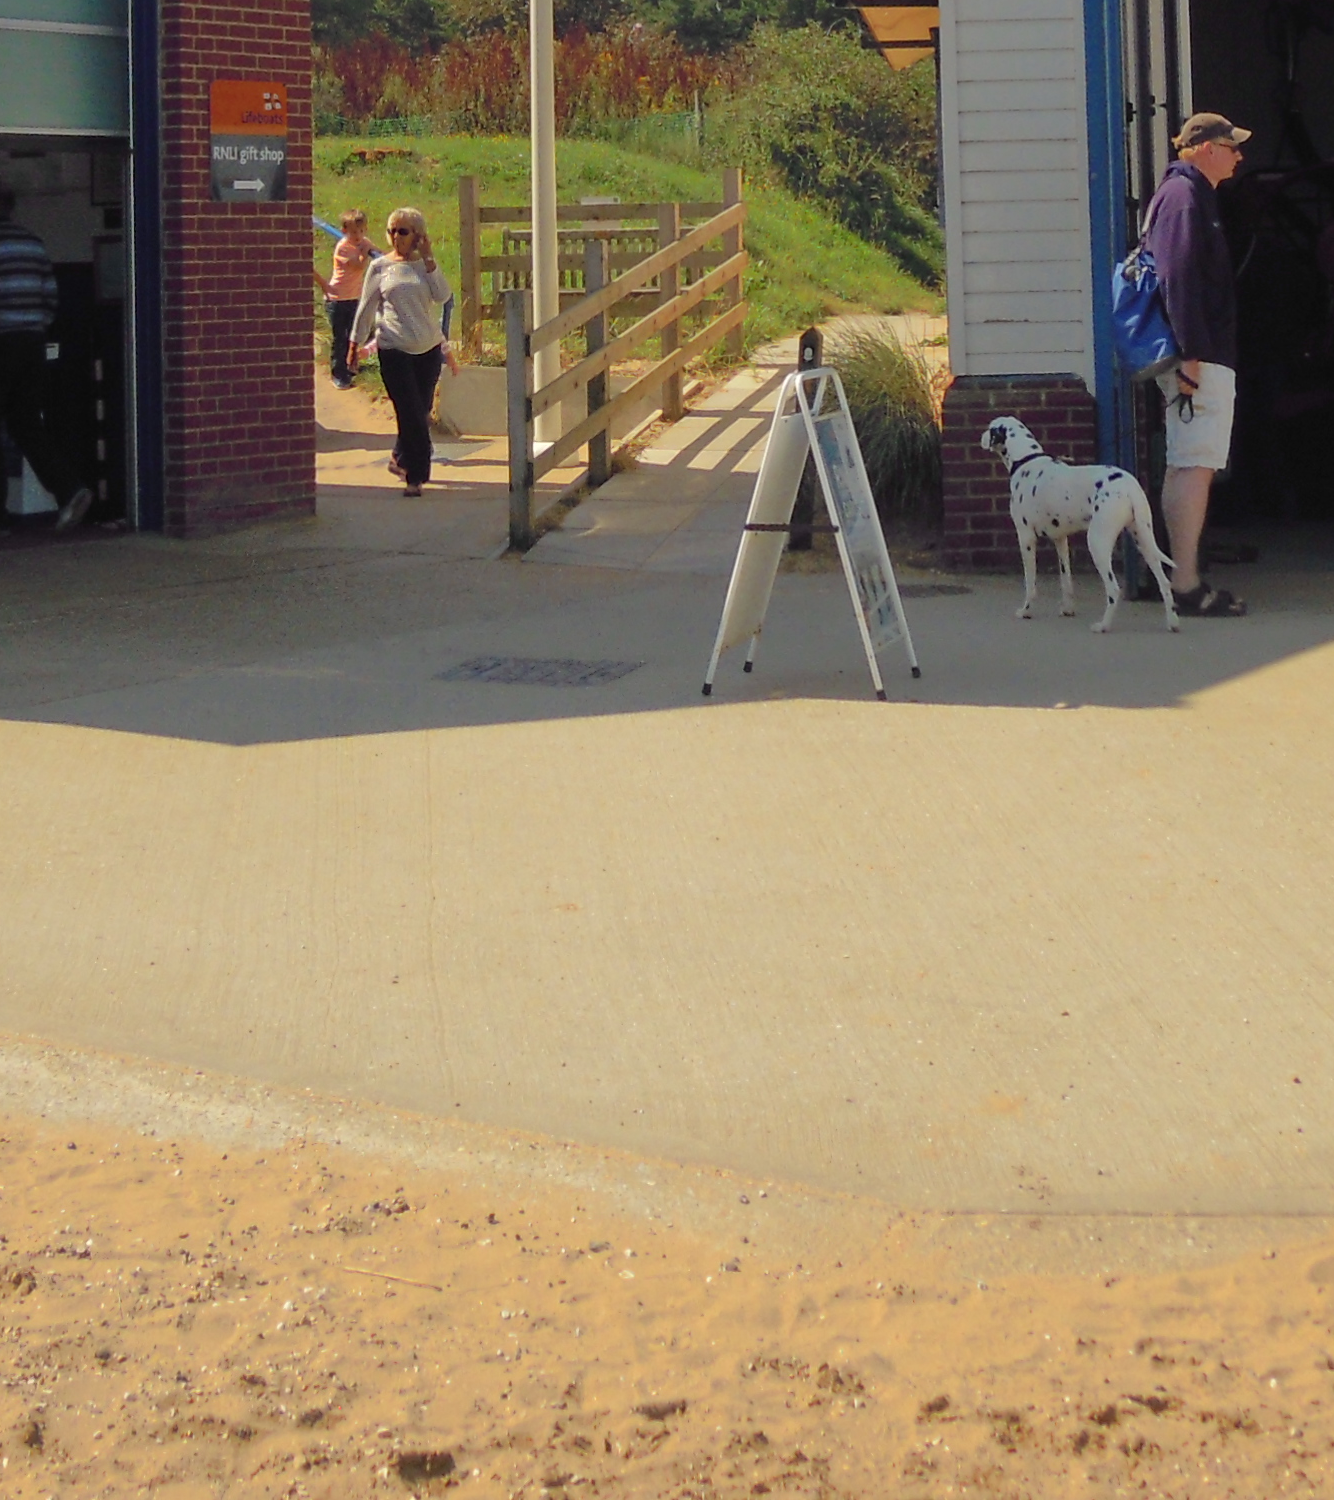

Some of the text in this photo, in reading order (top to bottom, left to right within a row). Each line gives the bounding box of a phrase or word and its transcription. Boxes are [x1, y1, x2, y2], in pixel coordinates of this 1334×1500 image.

[241, 111, 283, 124] Lifeboats
[213, 146, 284, 165] RNLI gift shop
